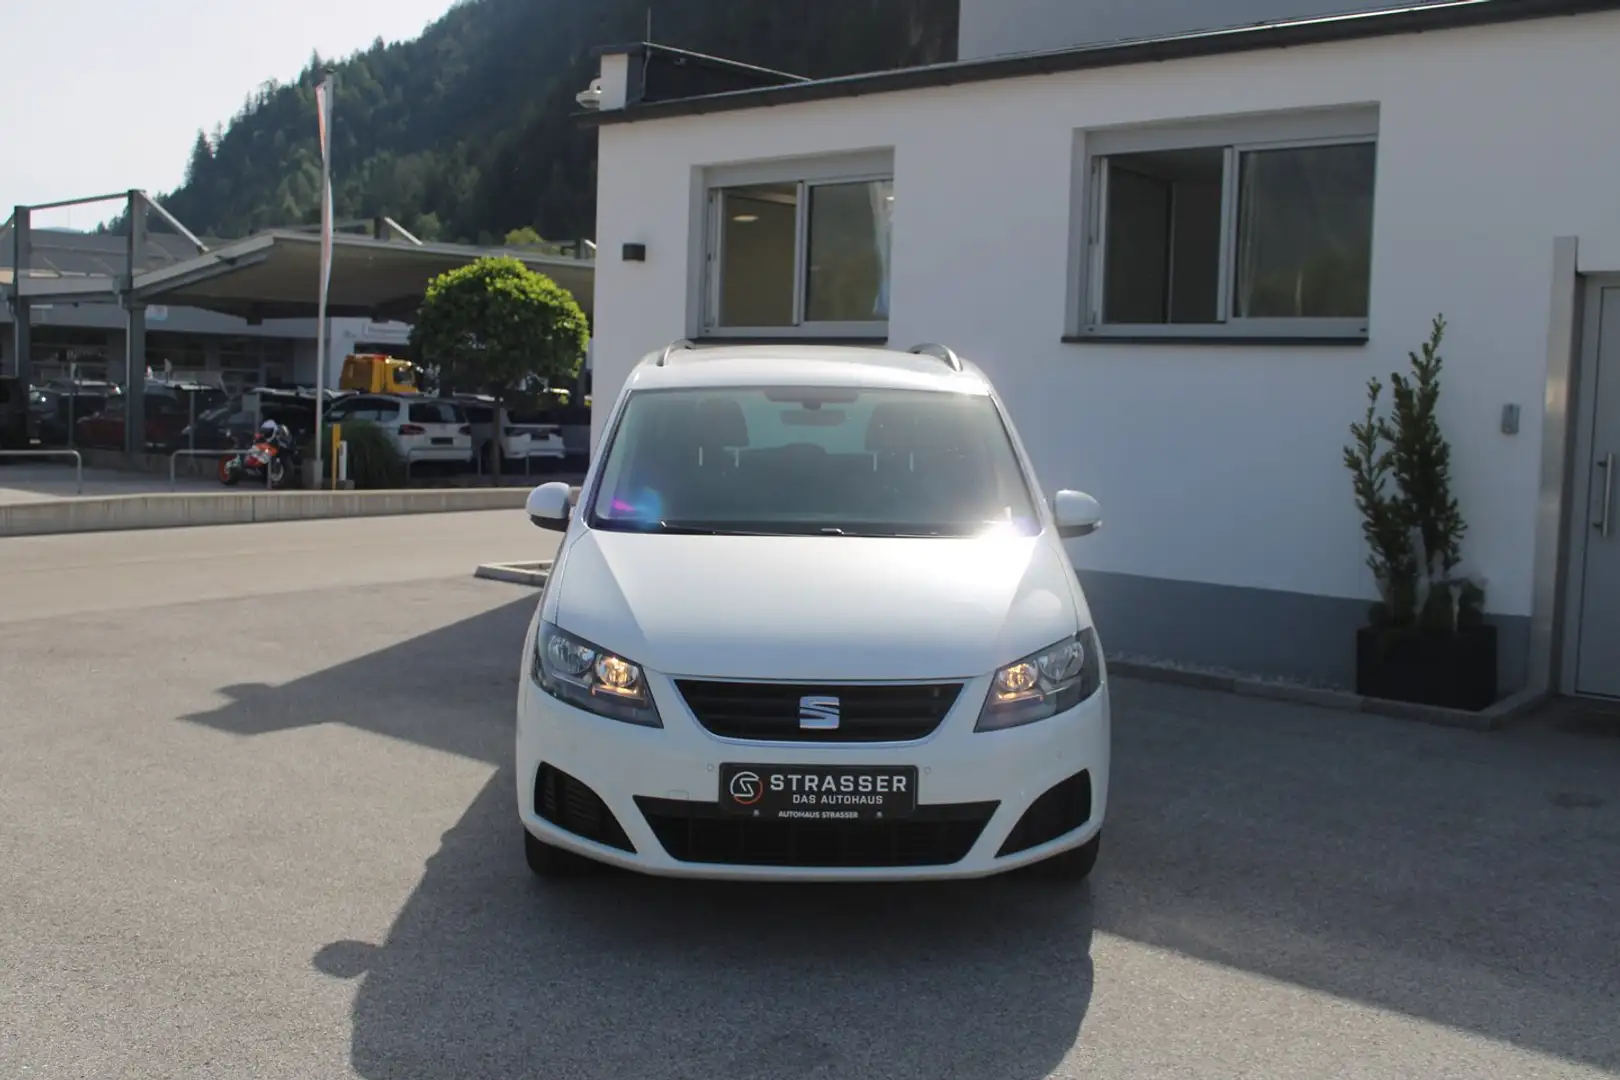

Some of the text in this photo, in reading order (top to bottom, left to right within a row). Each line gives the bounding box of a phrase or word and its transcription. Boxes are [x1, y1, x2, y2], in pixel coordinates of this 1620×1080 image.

[770, 774, 907, 792] STRASSER
[792, 794, 883, 805] DAS AUTOHAUS
[778, 810, 859, 819] AUTOHAUS STRASSER
